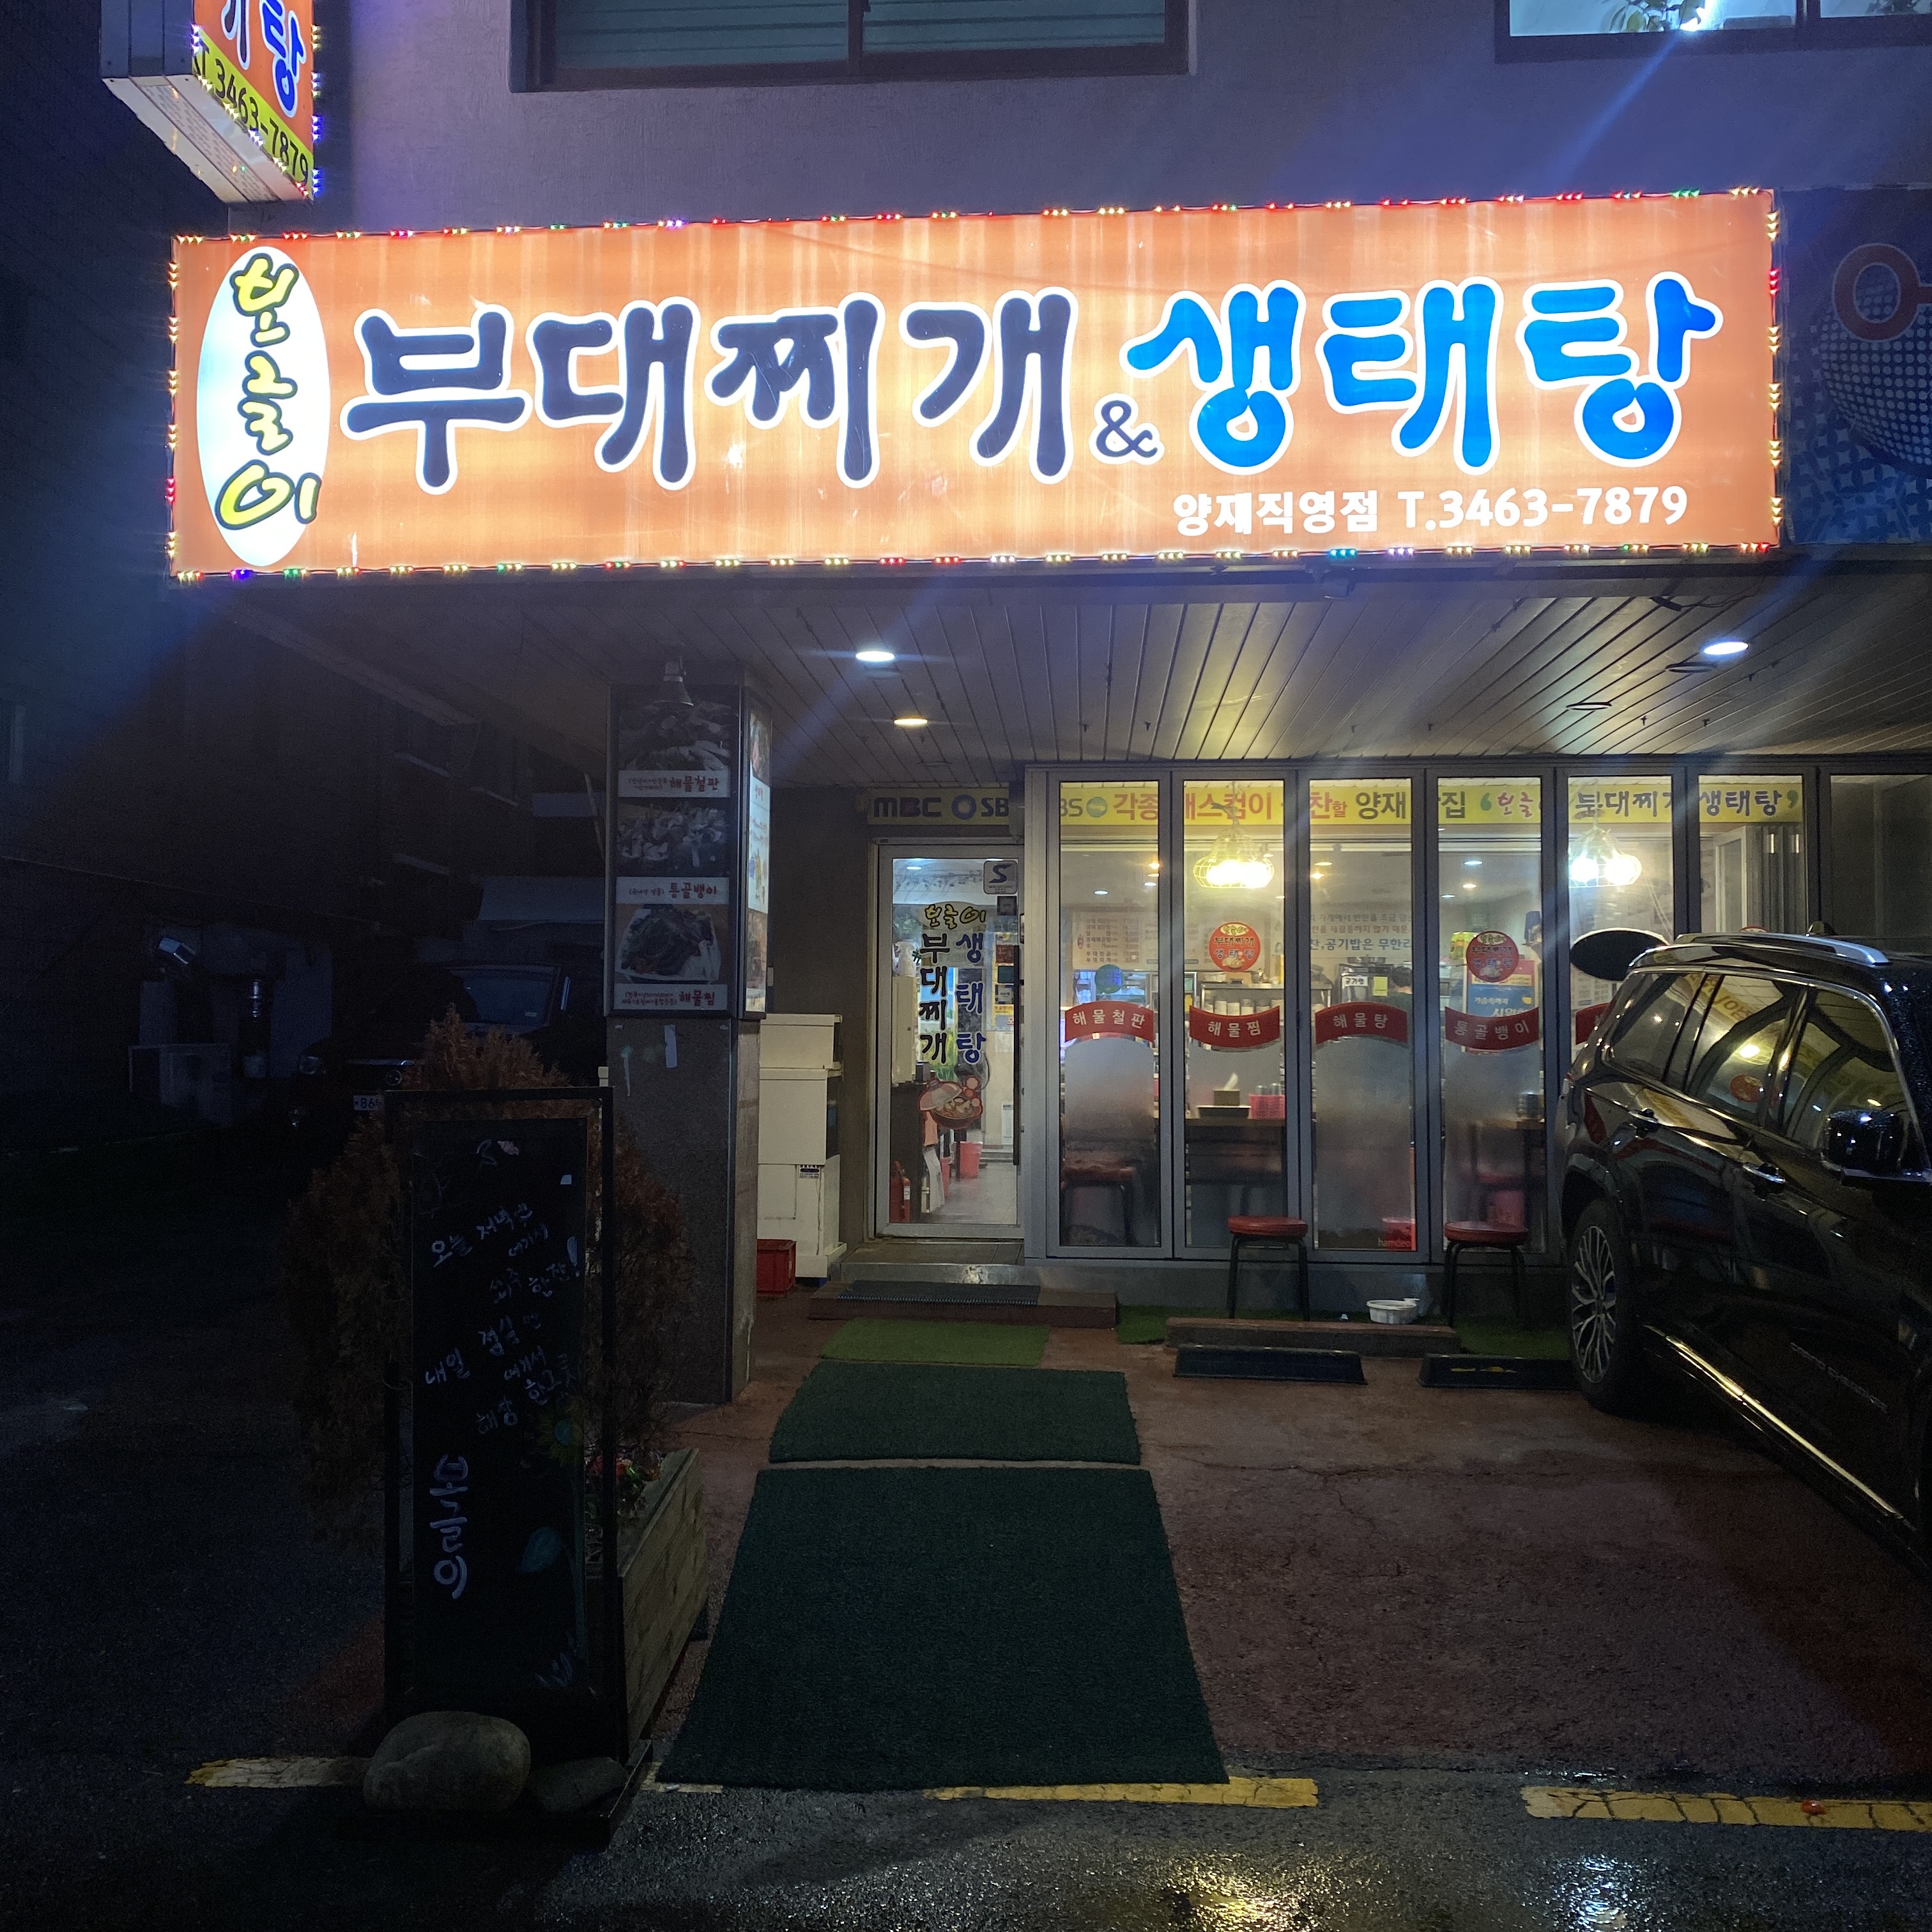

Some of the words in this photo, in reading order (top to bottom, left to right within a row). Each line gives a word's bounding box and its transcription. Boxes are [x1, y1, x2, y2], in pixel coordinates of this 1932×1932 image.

[1120, 271, 1724, 476] 생태탕
[215, 253, 321, 530] 보글이
[341, 287, 1078, 495] 부대찌개
[1090, 392, 1164, 465] &
[1173, 489, 1378, 535] 양재직영점
[1397, 484, 1688, 532] T.3463-7879
[670, 775, 719, 792] 해물철판
[981, 797, 1009, 818] SB
[1310, 792, 1347, 819] 찬할
[1356, 791, 1406, 820] 양재
[1438, 791, 1466, 818] 집
[669, 882, 717, 898] 통골뱅이
[924, 903, 987, 930] 보글이
[1215, 937, 1254, 947] 부대찌개
[678, 989, 715, 1006] 해물찜
[919, 933, 951, 1064] 부대찌개
[955, 932, 987, 1064] 생태탕
[1071, 1009, 1146, 1030] 해물철판
[1208, 1020, 1261, 1038] 해물찜
[1333, 1013, 1388, 1029] 해물탕
[1453, 1020, 1530, 1041] 통골뱅이
[431, 1234, 474, 1268] 오늘
[424, 1347, 471, 1385] 내일
[476, 1395, 519, 1435] 해장
